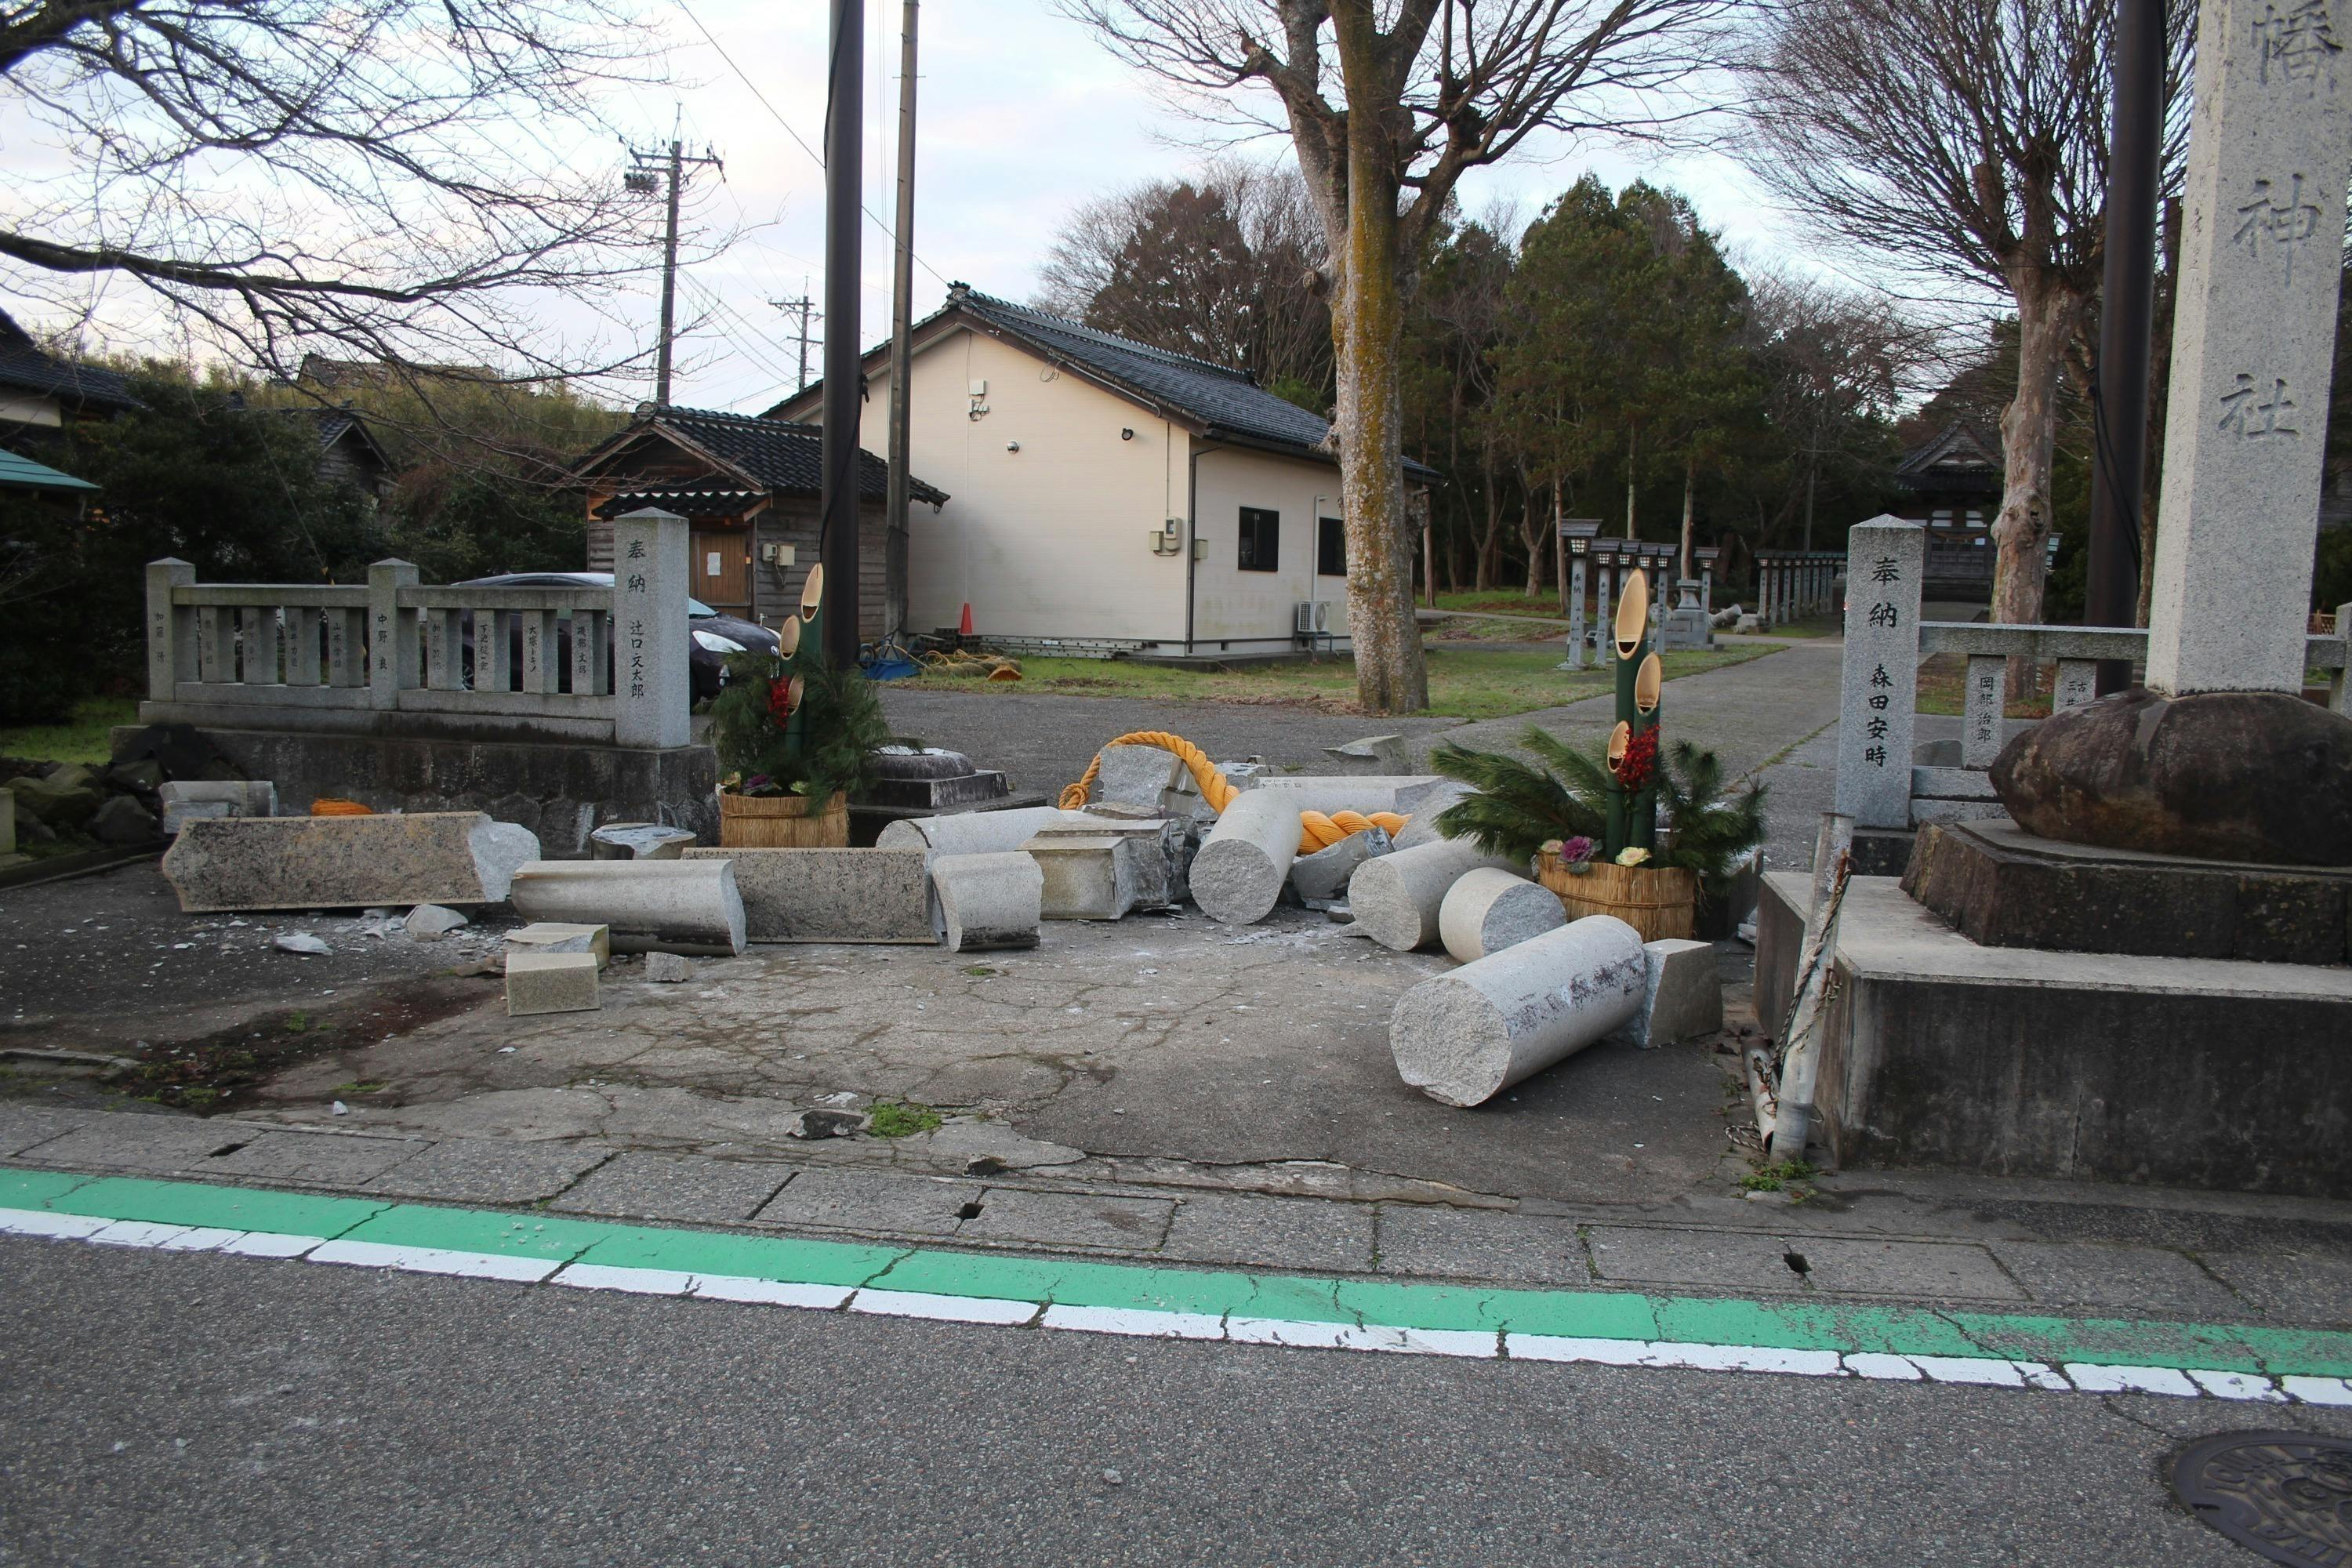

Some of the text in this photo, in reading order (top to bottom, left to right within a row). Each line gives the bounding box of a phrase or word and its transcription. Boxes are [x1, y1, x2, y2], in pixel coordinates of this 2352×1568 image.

[627, 539, 647, 700] 奉納 辻口文太郎
[1864, 556, 1900, 768] 奉納 森田安時
[2077, 681, 2088, 703] 古
